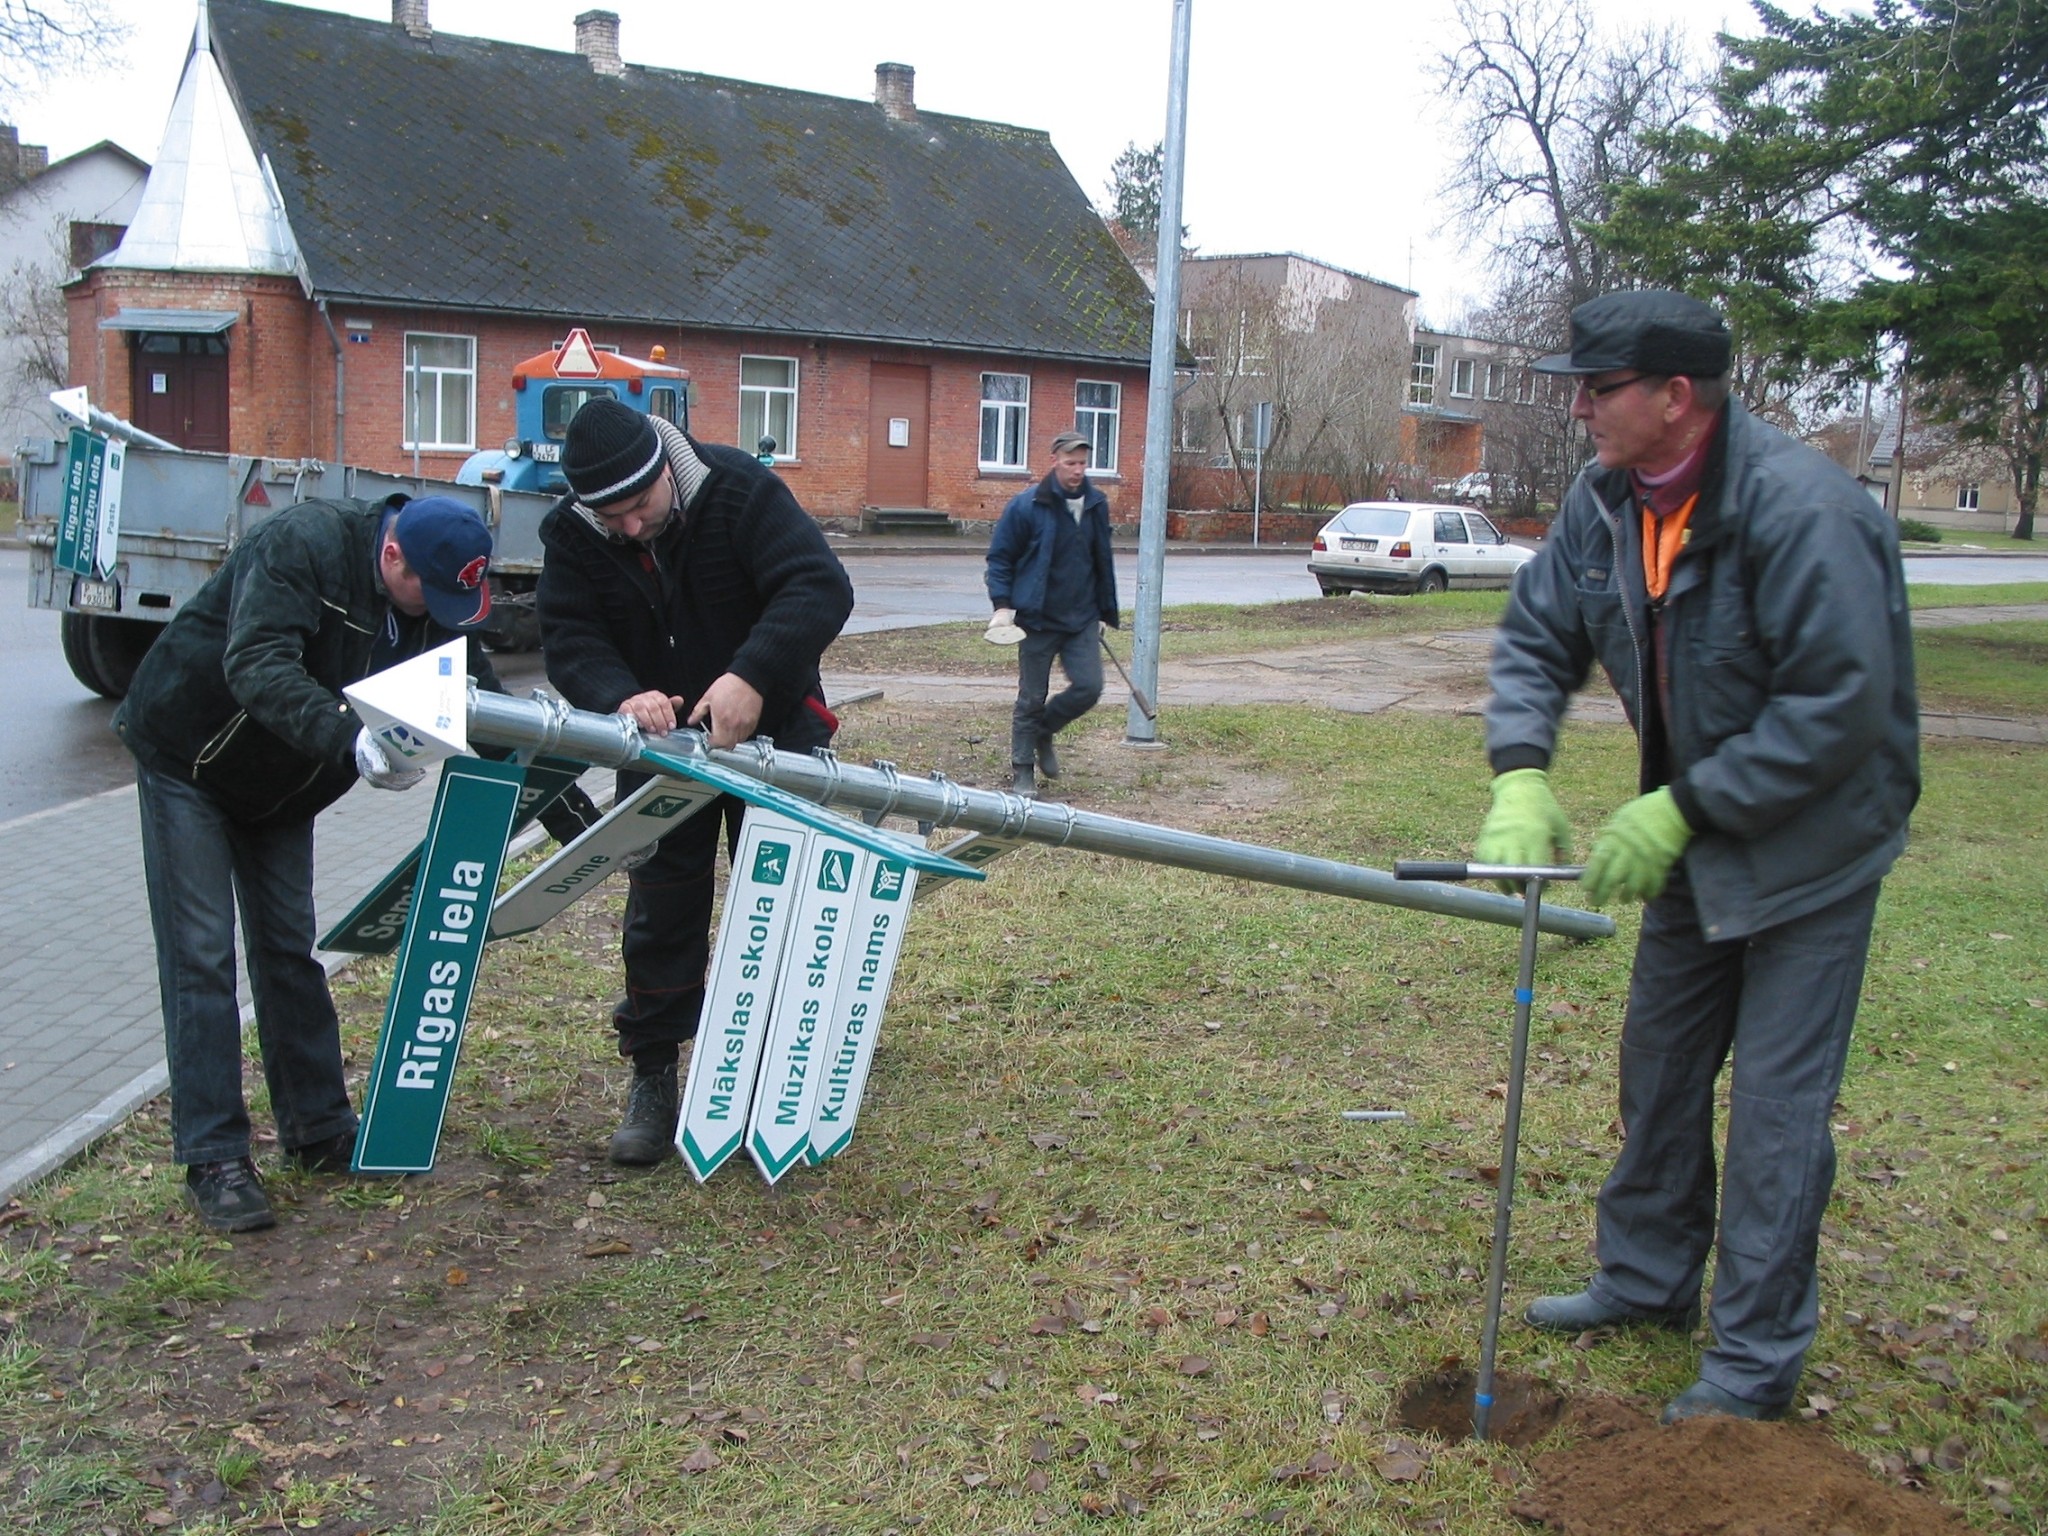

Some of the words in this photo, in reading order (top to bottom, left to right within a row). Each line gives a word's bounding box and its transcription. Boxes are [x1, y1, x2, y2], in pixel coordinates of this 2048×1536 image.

[65, 495, 79, 542] Rīgas
[70, 461, 82, 491] iela
[80, 489, 97, 562] Zvaigžņu
[89, 455, 101, 485] iela
[107, 503, 116, 535] Pasts
[543, 855, 610, 894] Dome
[395, 960, 461, 1090] Rīgas
[429, 860, 486, 944] iela
[706, 991, 754, 1120] Mākslas
[740, 896, 775, 980] skola
[774, 999, 820, 1125] Mūzikas
[806, 906, 839, 988] skola
[819, 1002, 868, 1122] Kultūras
[857, 913, 890, 992] nams
